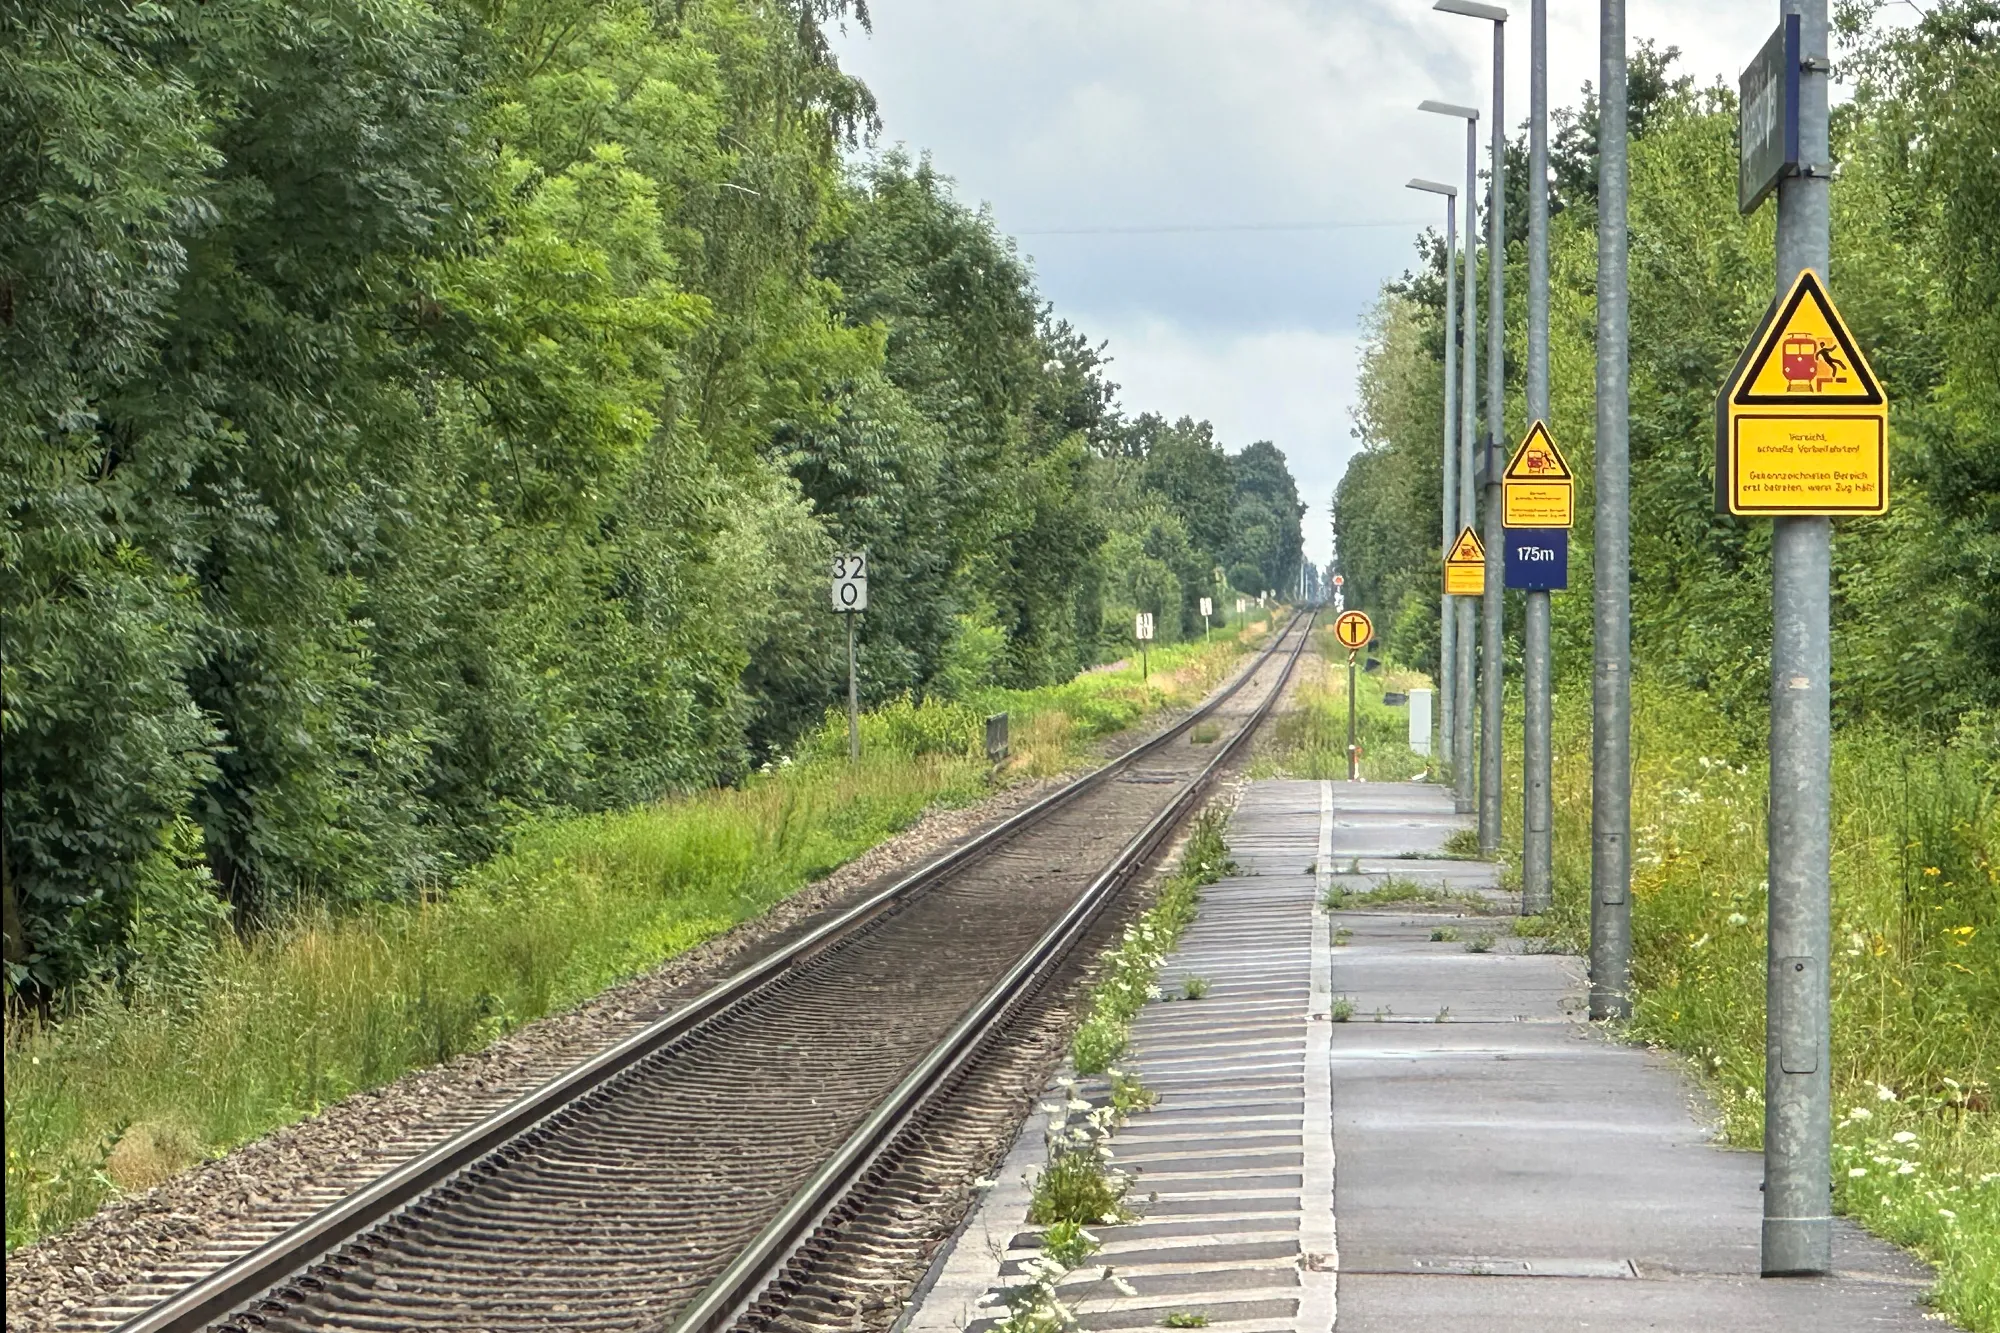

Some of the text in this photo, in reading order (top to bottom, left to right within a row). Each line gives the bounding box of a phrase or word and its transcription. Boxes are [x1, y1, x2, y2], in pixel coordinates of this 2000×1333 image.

[1516, 546, 1555, 561] 175m
[833, 556, 865, 579] 32
[841, 583, 857, 606] 0
